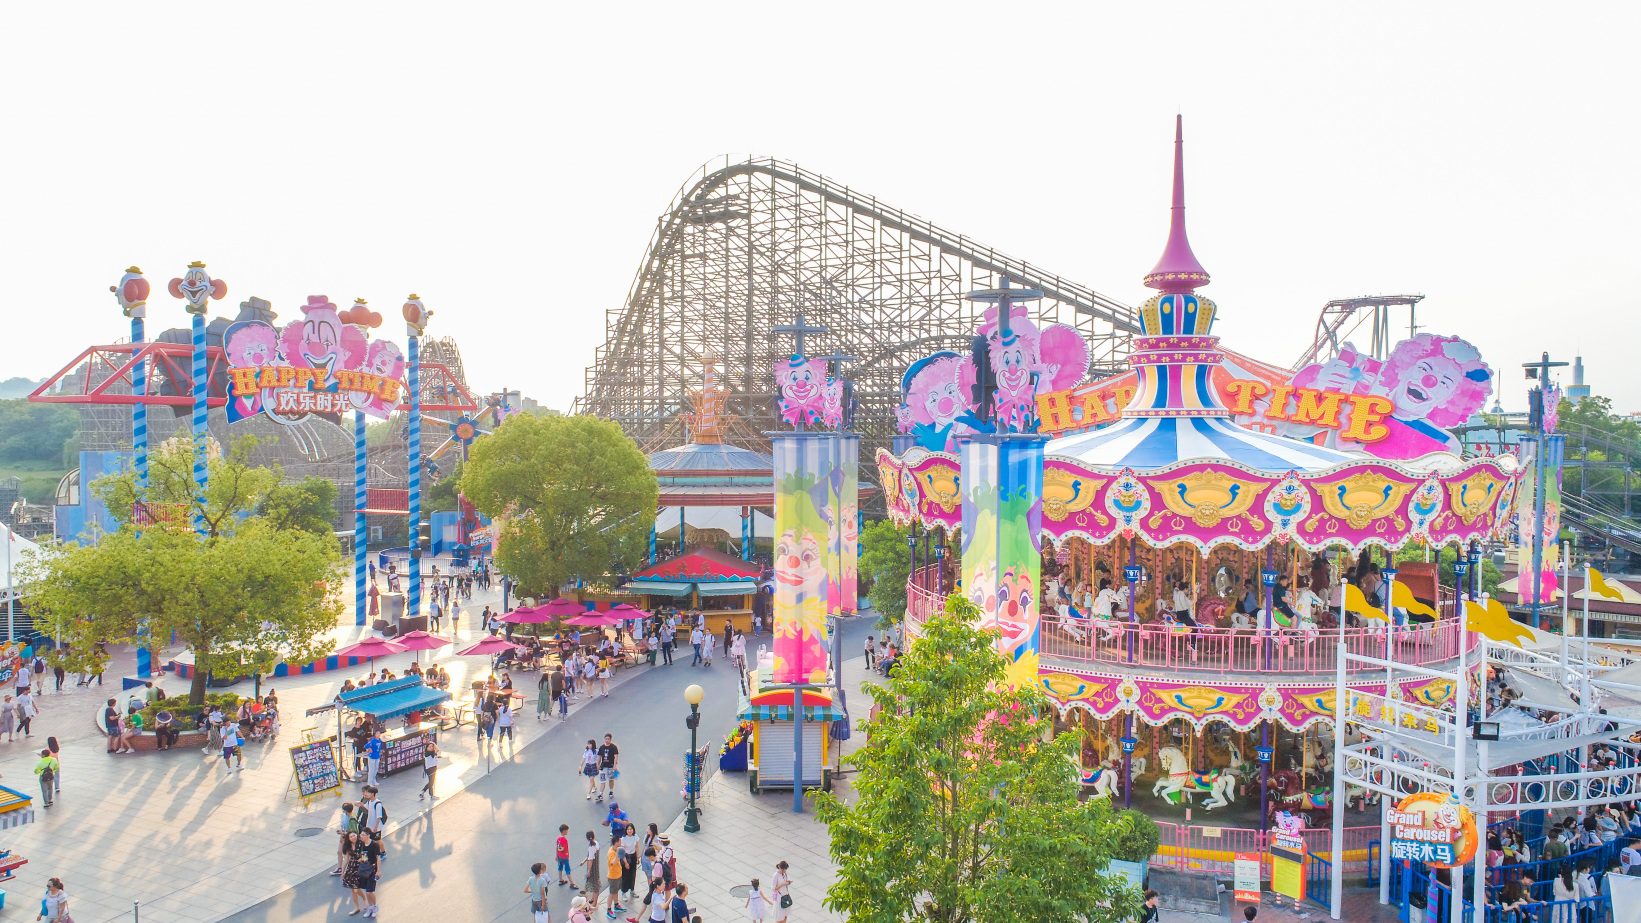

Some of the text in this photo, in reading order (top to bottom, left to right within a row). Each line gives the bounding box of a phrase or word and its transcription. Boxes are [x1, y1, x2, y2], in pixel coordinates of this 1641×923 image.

[229, 366, 401, 402] HAPPY TIME
[279, 392, 350, 413] 欢乐时光
[1036, 379, 1393, 441] HAP TIME
[1355, 699, 1440, 736] 旋转木马
[1386, 808, 1424, 826] Grand
[1395, 824, 1451, 843] Carousel
[1391, 841, 1452, 864] 旋转木马
